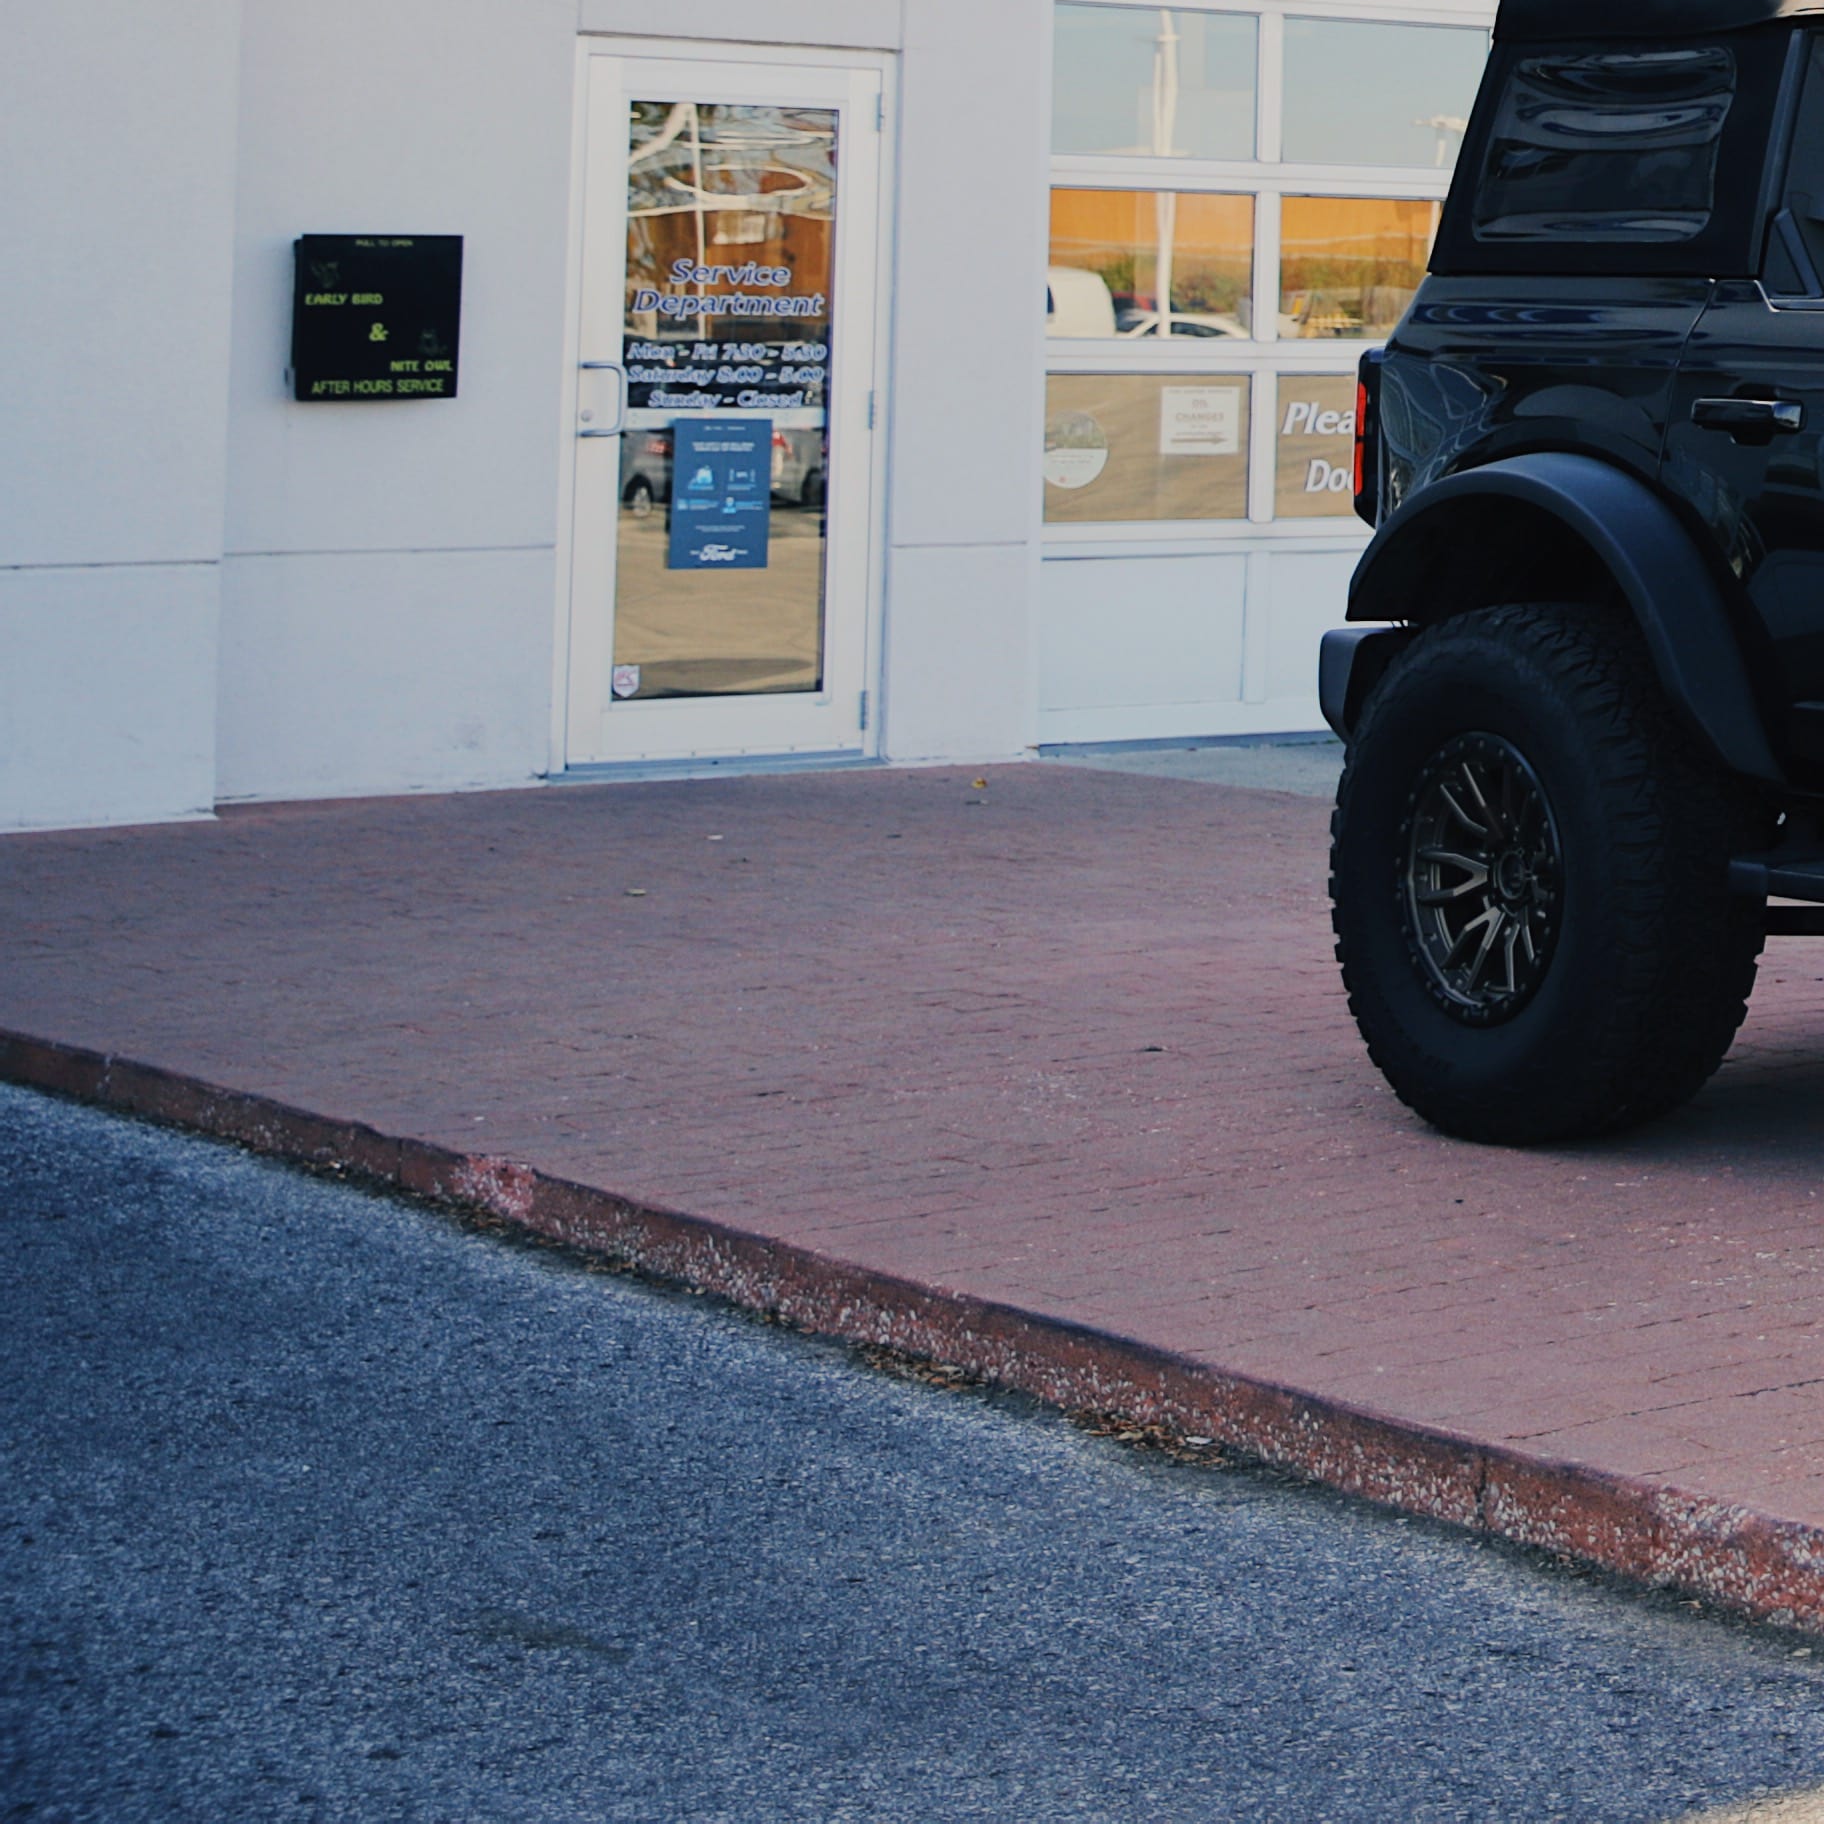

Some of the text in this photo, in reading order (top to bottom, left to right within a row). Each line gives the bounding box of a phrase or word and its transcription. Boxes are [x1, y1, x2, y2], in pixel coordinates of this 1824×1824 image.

[669, 257, 791, 286] Service
[305, 293, 384, 306] EARLY BIRD
[632, 289, 825, 321] Department
[368, 323, 389, 342] &
[390, 360, 453, 372] NITE OWL
[627, 365, 716, 386] Saturday
[312, 378, 444, 394] AFTER HOURS SERVICE
[648, 389, 722, 408] Sunday
[737, 389, 803, 407] Closed
[1282, 401, 1355, 435] Plea
[699, 544, 737, 561] Ford
